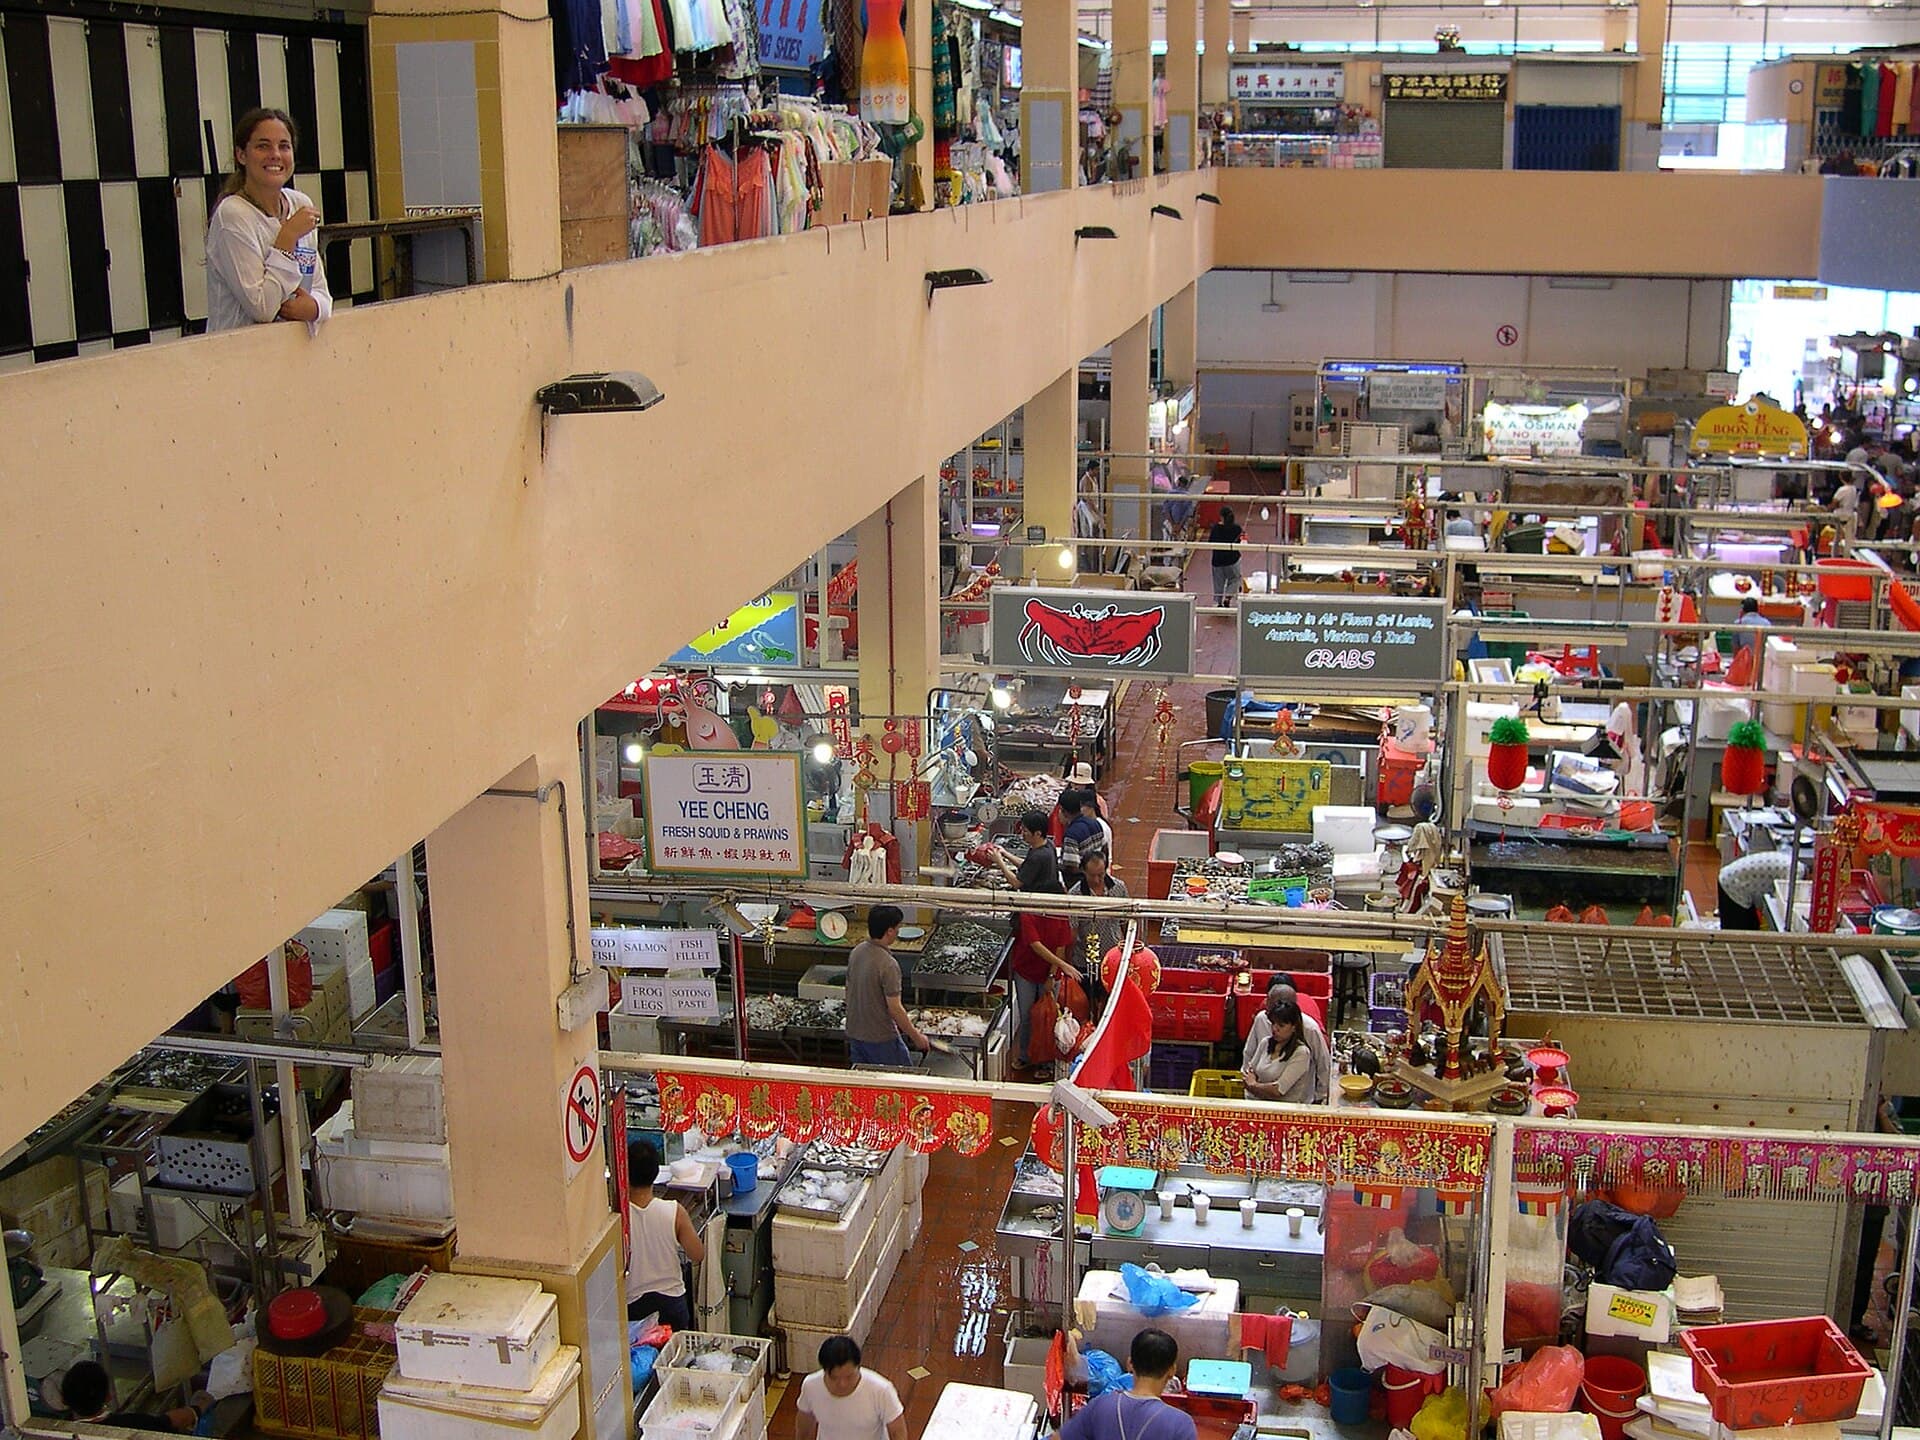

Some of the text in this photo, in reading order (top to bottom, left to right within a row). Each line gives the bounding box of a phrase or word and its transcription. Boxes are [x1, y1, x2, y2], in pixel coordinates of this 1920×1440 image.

[773, 36, 802, 61] SHOES
[1524, 421, 1577, 431] OSMAN
[1713, 424, 1789, 436] BOON LENG
[1248, 611, 1434, 630] Specialist in Air Flown Sri Lanka,
[1265, 628, 1417, 645] Australia, Vietnam & India
[1304, 648, 1377, 671] CRABS
[698, 766, 745, 788] 玉清
[678, 800, 769, 821] YEE CHENG
[662, 826, 789, 841] FRESH SQUID & PRAWNS
[592, 939, 616, 949] COD
[624, 943, 668, 953] SALMON
[680, 939, 703, 949] FISH
[592, 951, 616, 961] FISH
[675, 951, 711, 961] FILLET
[632, 986, 663, 997] FROG
[671, 988, 711, 998] SOTONG
[633, 999, 664, 1011] LEGS
[678, 1001, 708, 1009] PASTE
[1617, 1297, 1652, 1311] BROCCOLI
[1618, 1303, 1645, 1318] 899
[1433, 1349, 1466, 1363] 01-72
